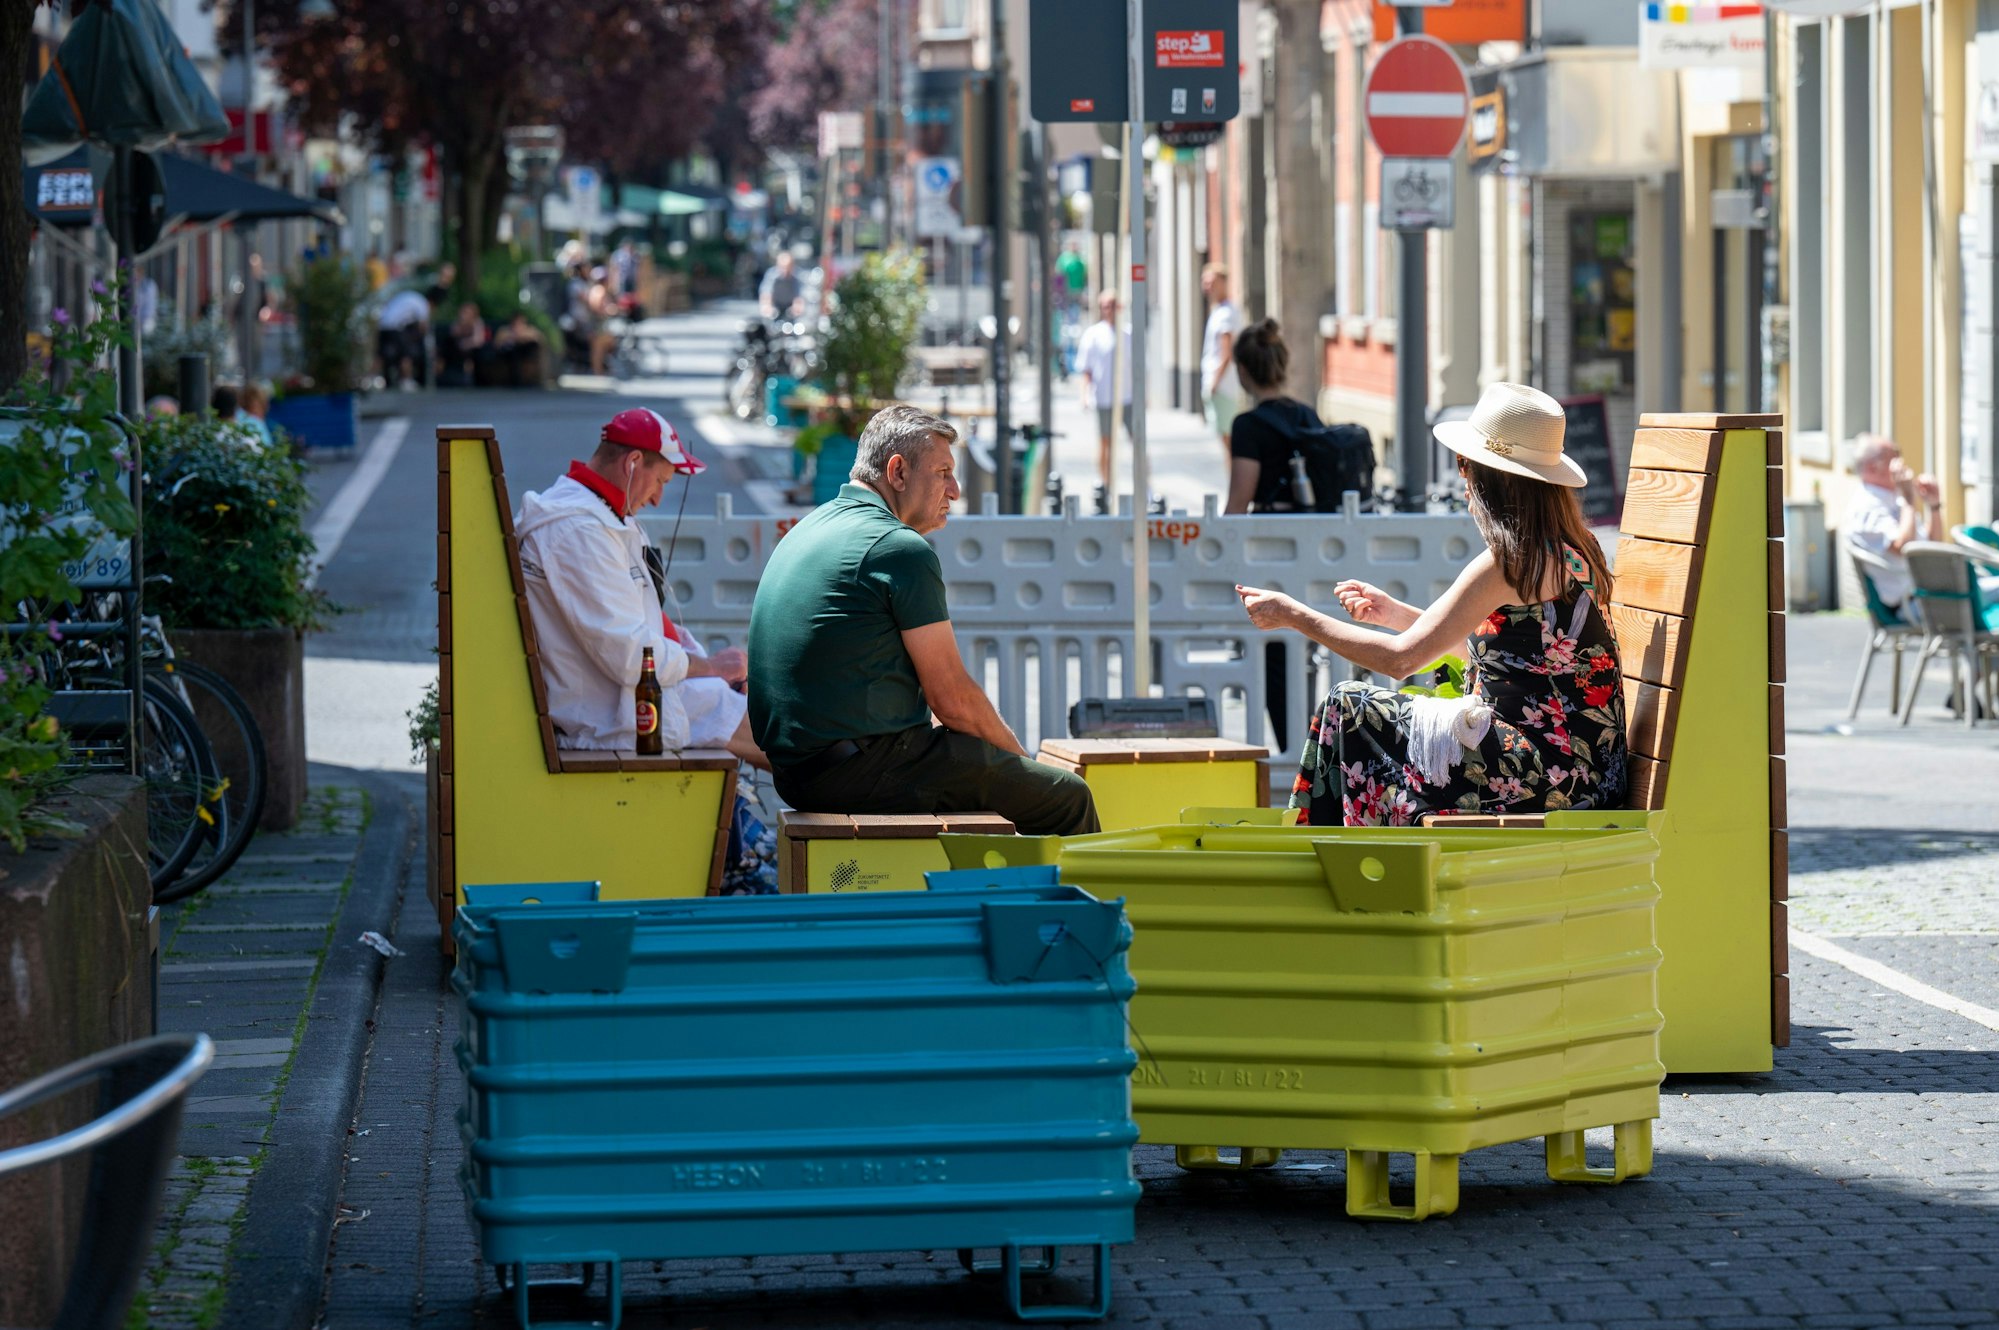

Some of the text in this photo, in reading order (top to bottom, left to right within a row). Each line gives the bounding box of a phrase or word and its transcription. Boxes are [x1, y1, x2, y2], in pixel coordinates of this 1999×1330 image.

[1157, 36, 1190, 53] step
[96, 558, 122, 577] 89
[1131, 1064, 1162, 1085] ON
[1275, 1068, 1303, 1090] 22
[672, 1160, 765, 1191] HESON
